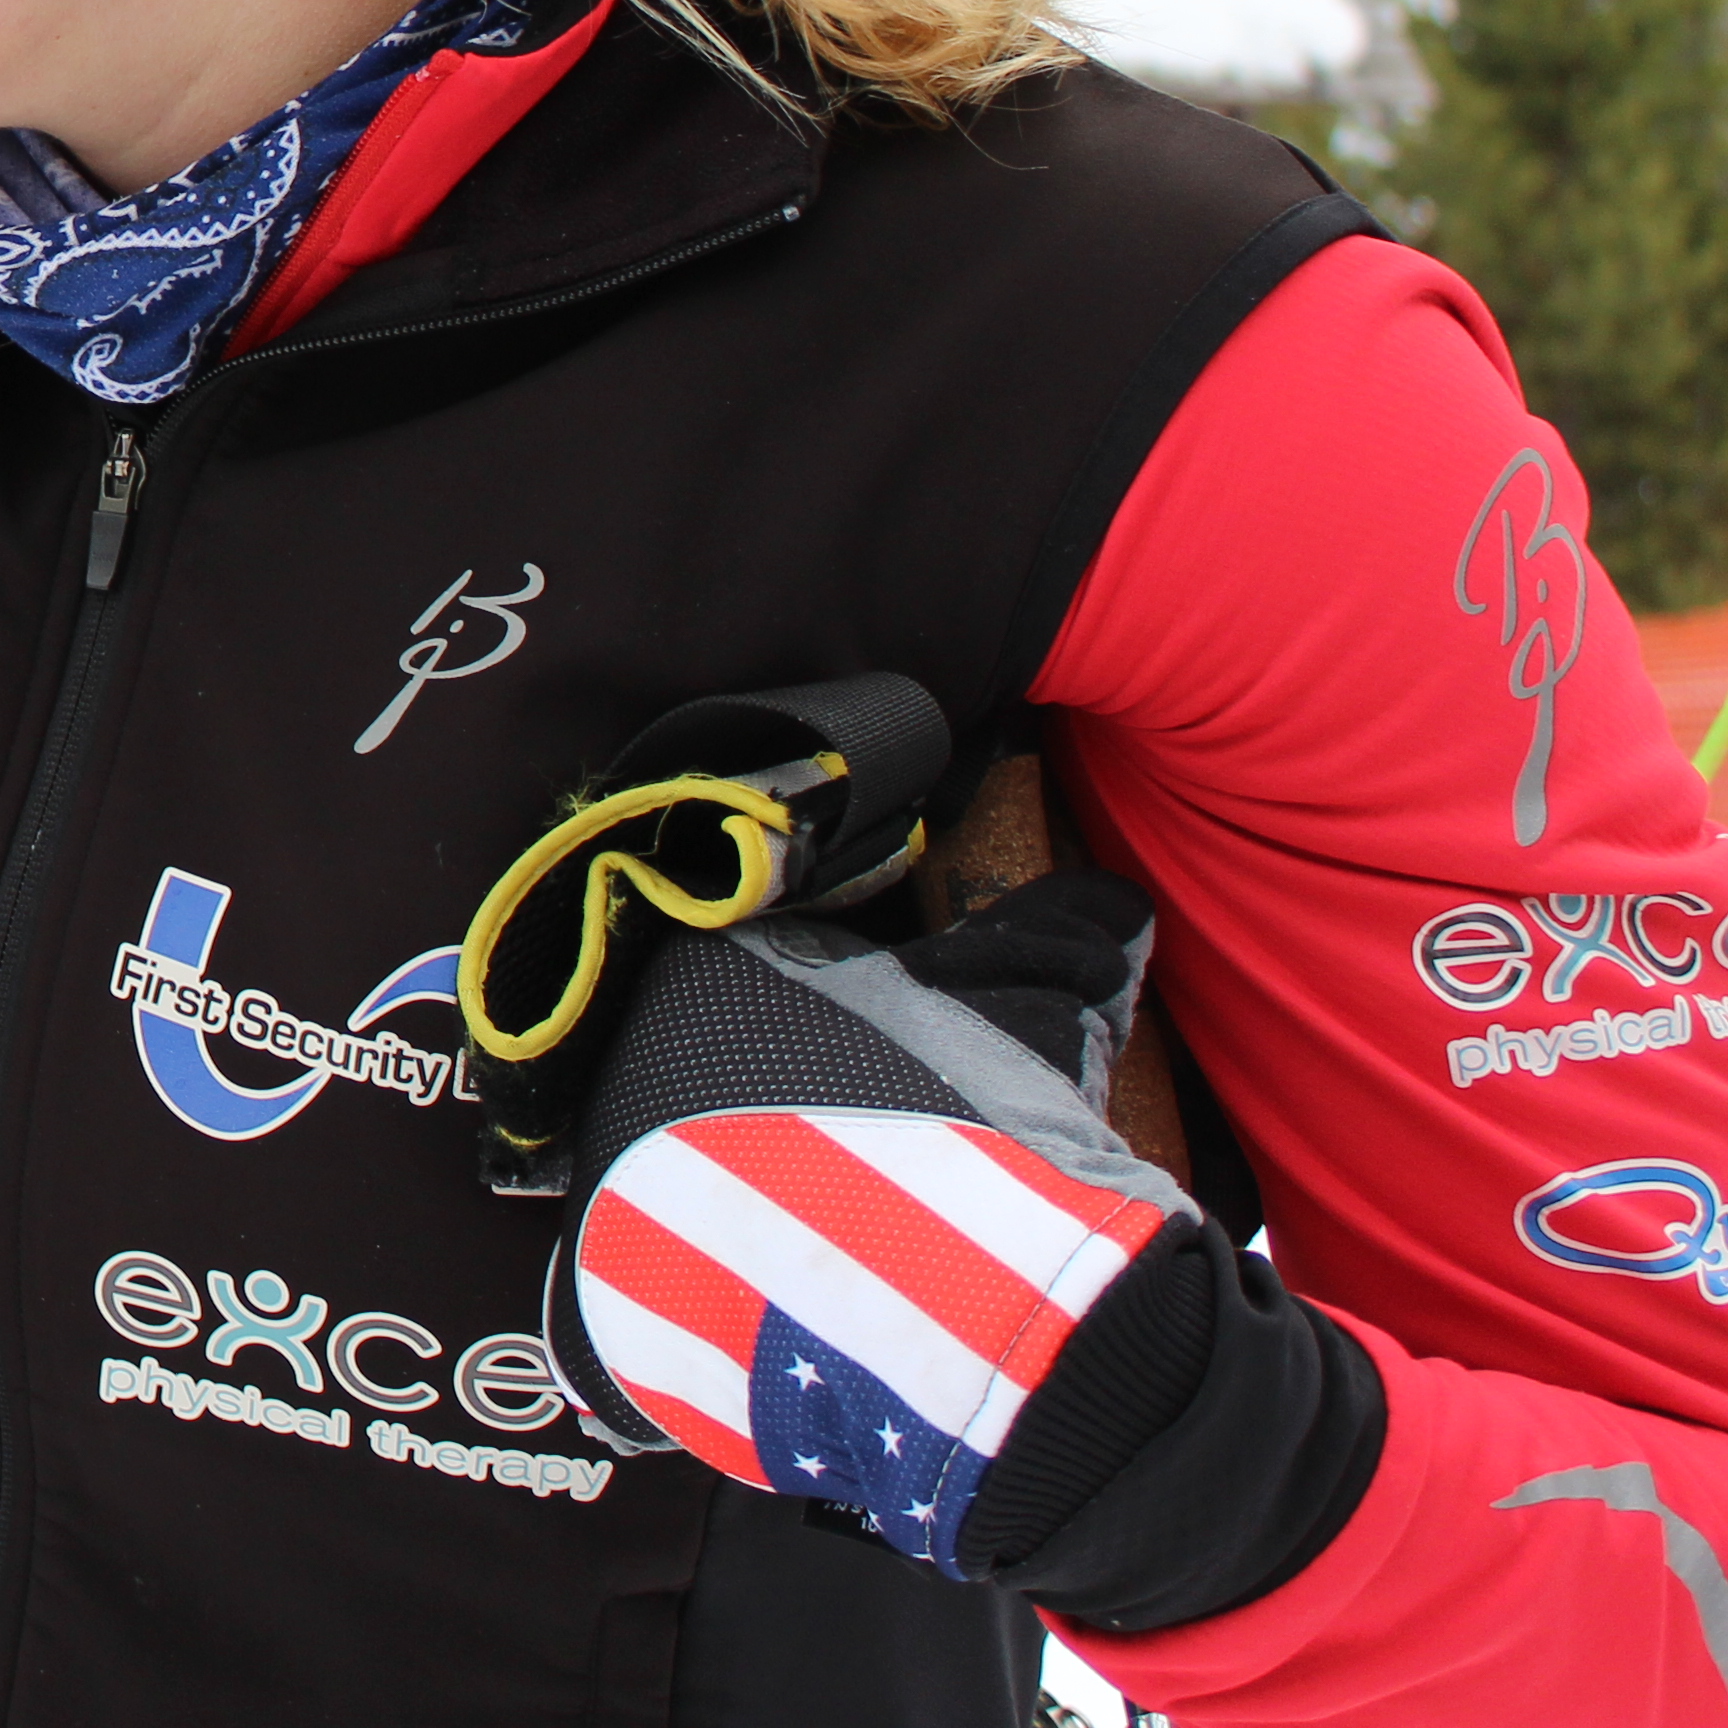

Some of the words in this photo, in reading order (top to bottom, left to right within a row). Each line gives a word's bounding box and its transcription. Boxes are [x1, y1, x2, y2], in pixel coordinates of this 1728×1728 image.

[117, 950, 225, 1026] First
[236, 996, 443, 1098] Security
[1455, 996, 1687, 1083] physical
[97, 1253, 562, 1429] exce
[105, 1359, 346, 1443] physical
[371, 1423, 608, 1498] therapy
